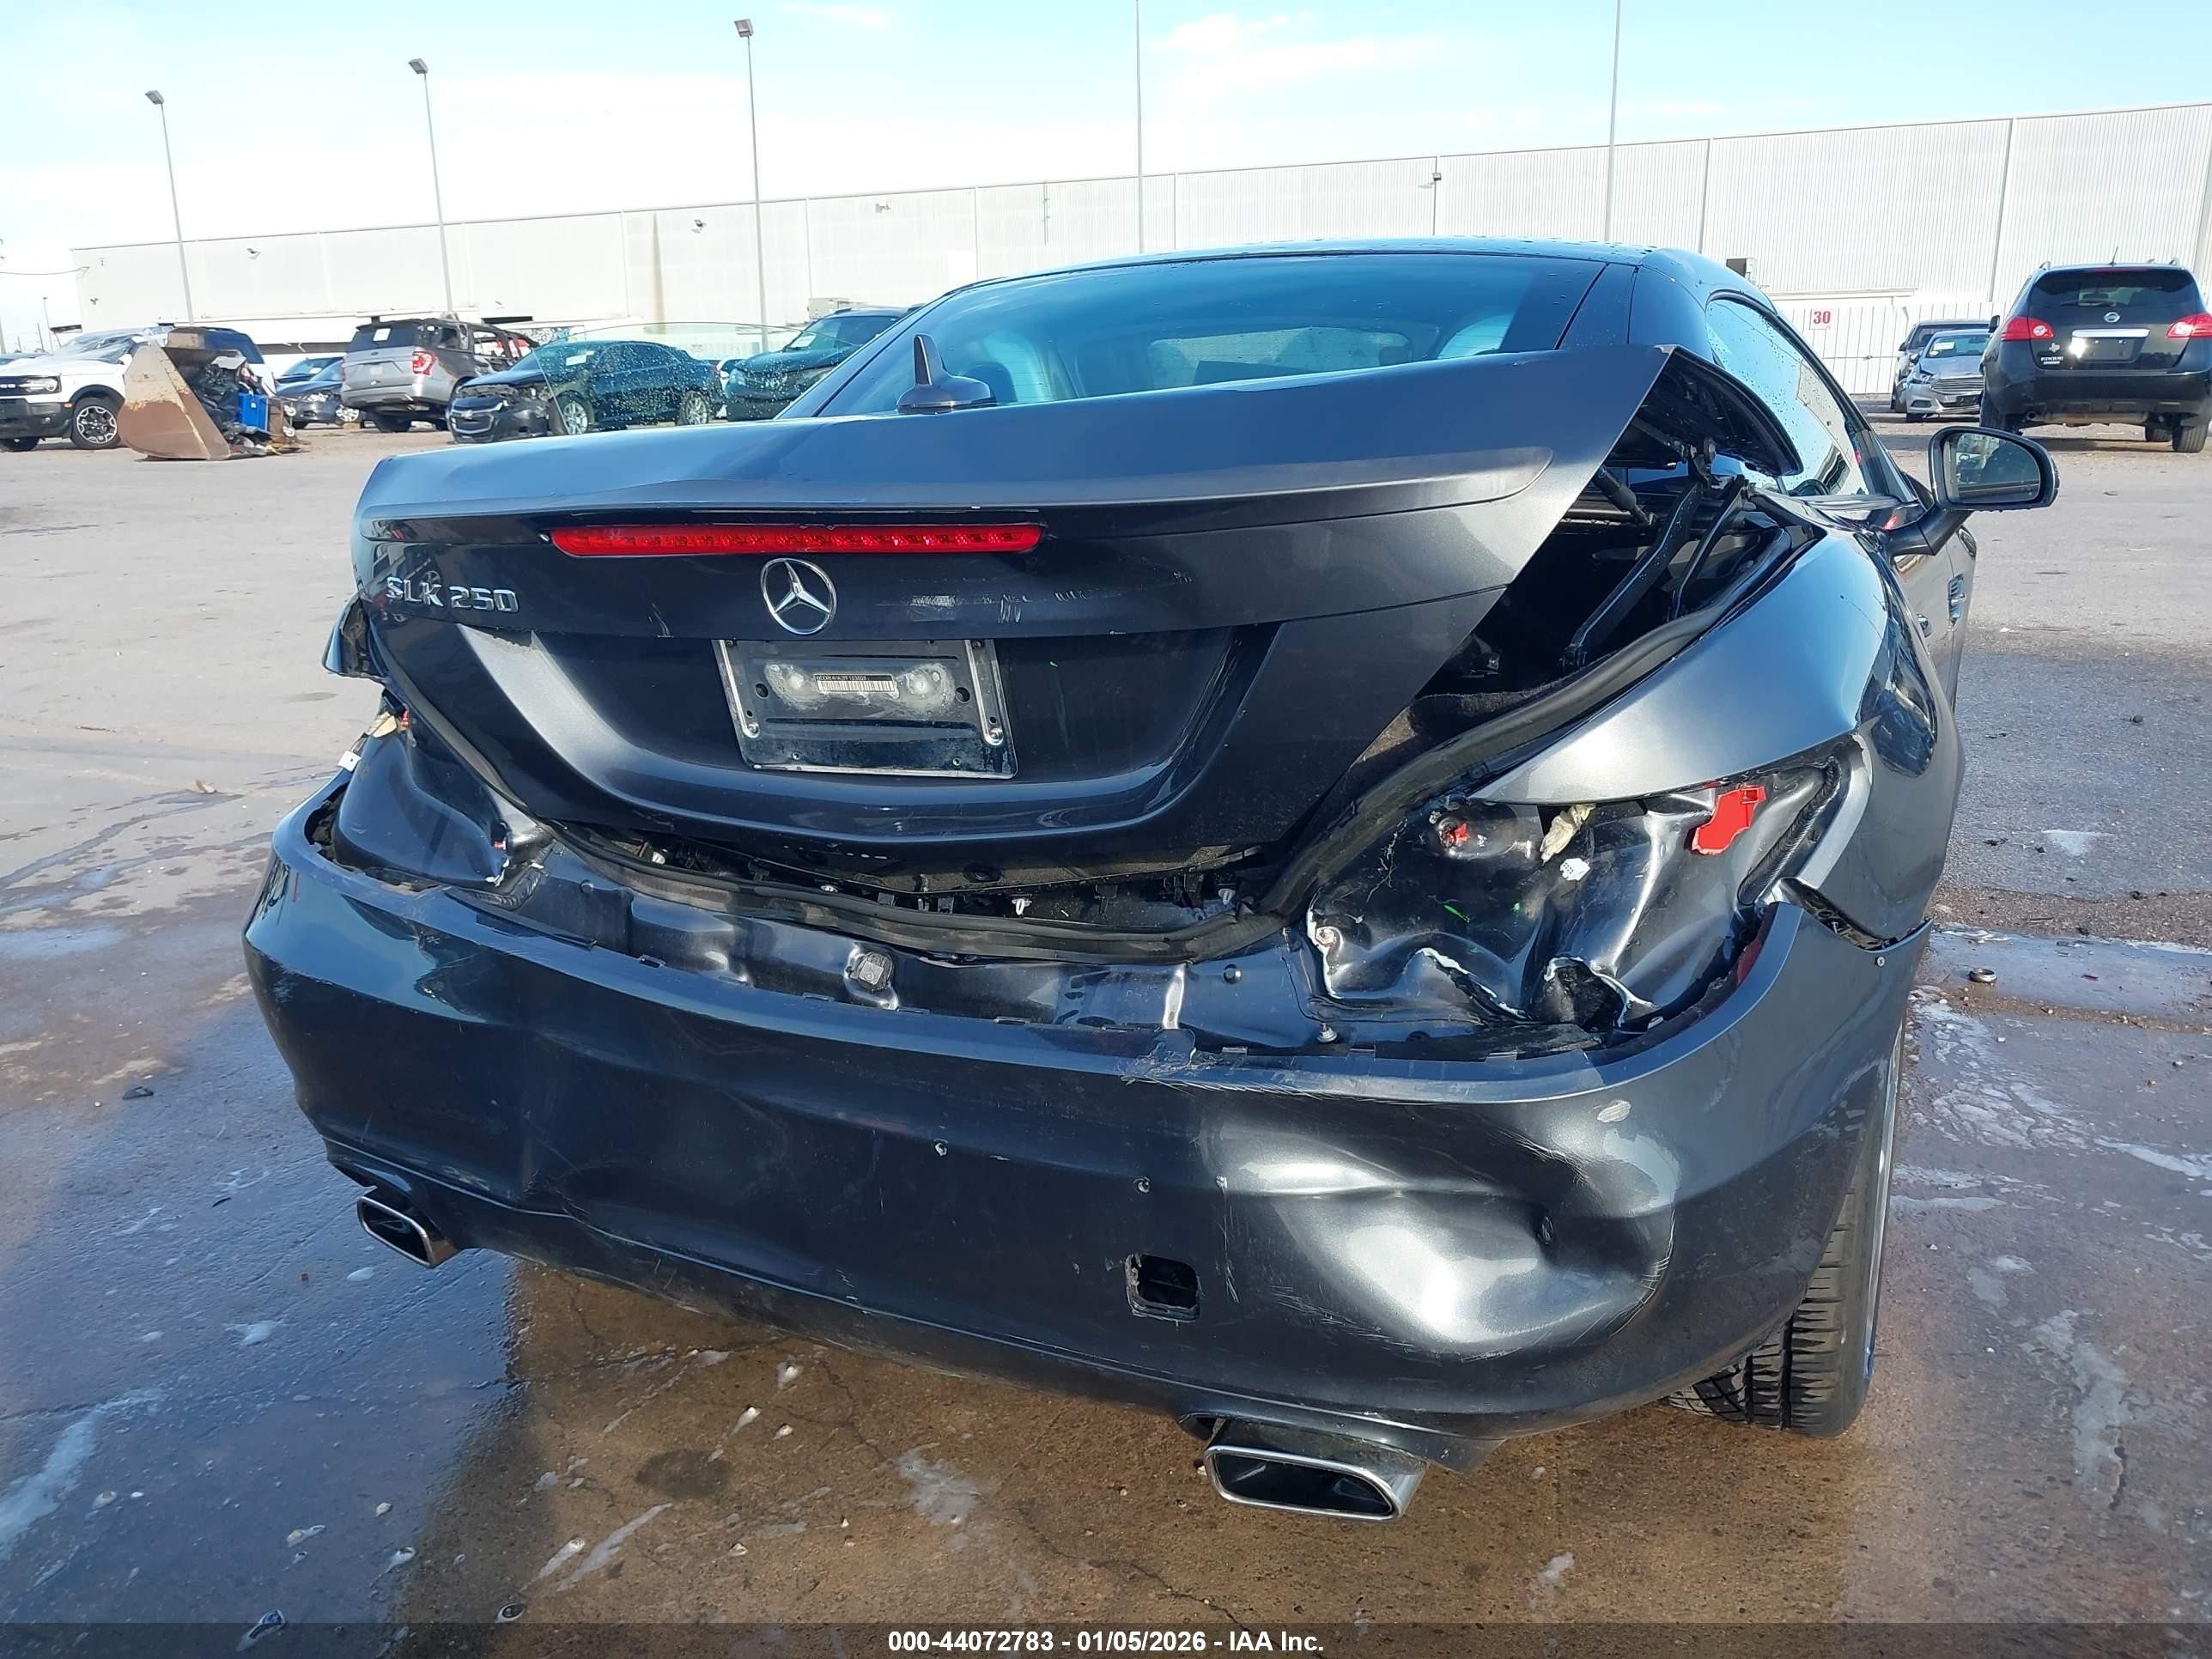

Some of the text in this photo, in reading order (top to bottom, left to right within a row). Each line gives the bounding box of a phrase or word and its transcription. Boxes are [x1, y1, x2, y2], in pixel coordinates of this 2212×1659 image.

[1813, 310, 1831, 325] 30
[386, 576, 520, 612] SLK 250
